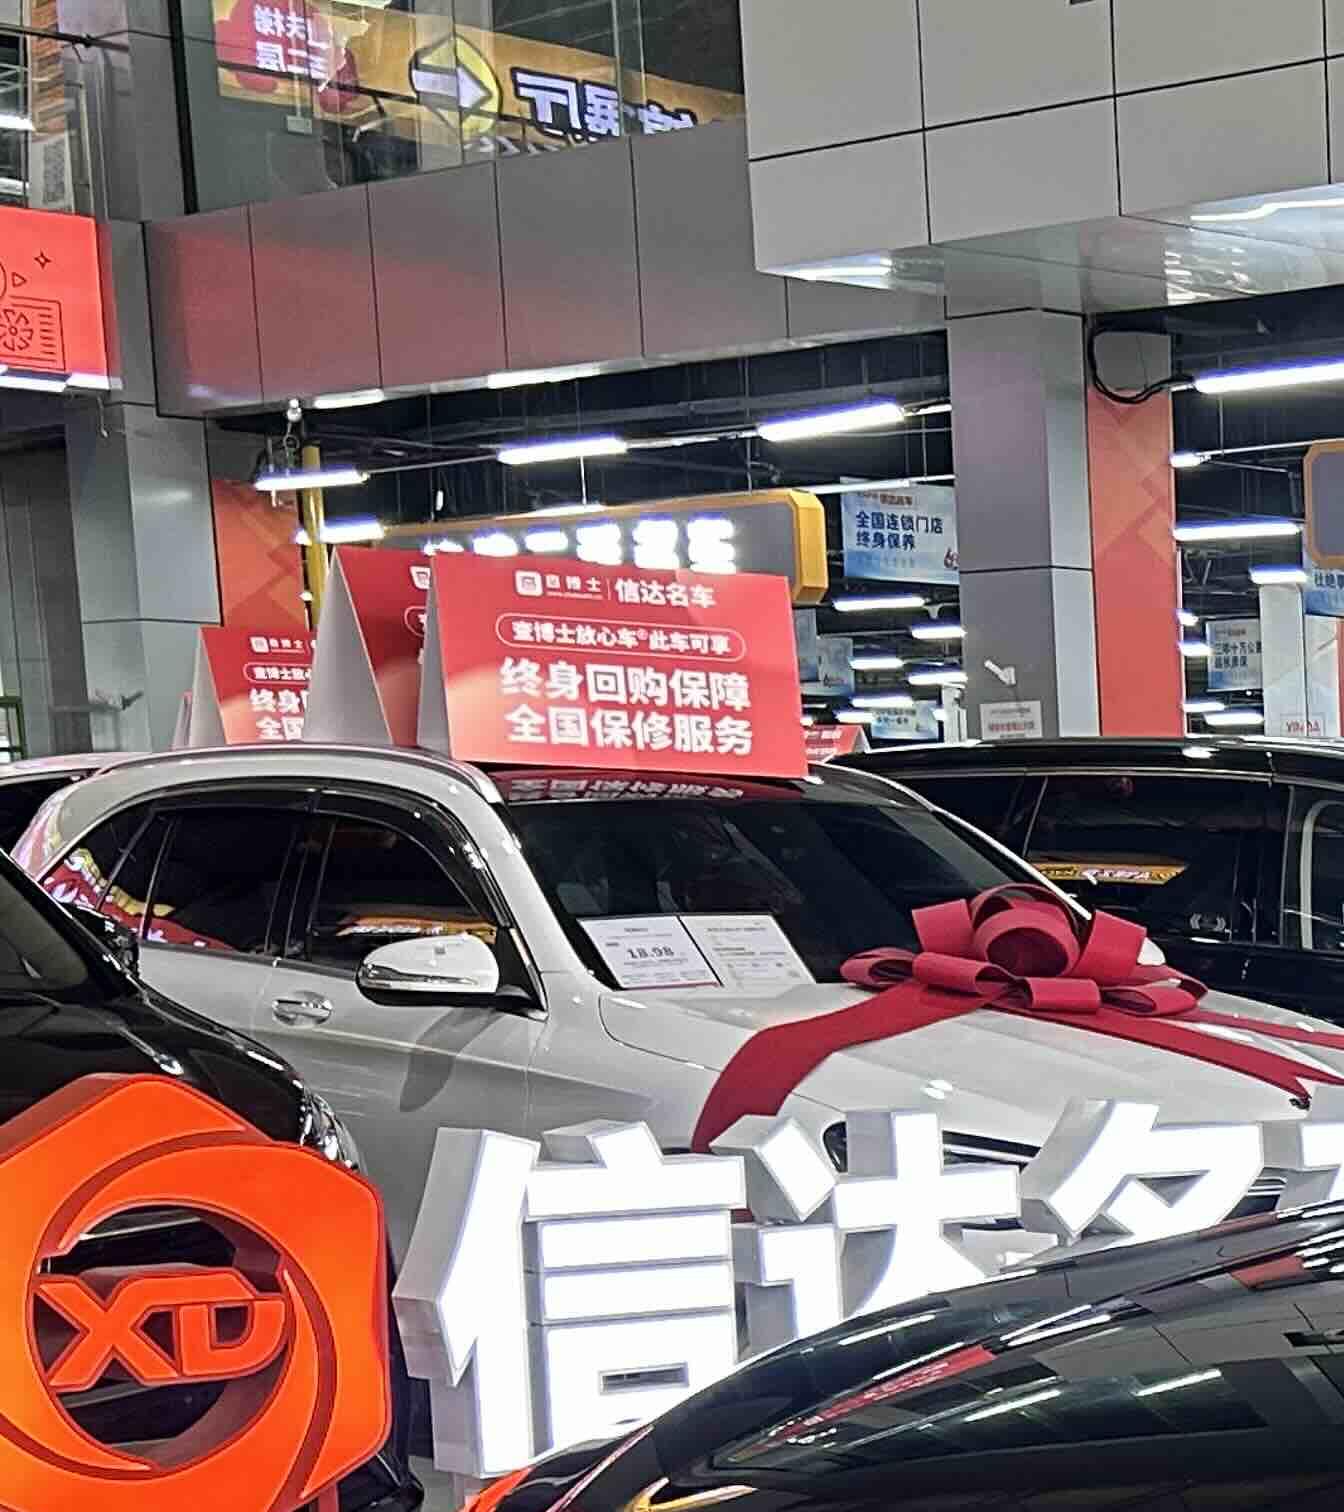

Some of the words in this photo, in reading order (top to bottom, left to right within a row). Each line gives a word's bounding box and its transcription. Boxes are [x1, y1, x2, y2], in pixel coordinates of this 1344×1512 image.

[615, 577, 717, 609] 信达名车
[250, 688, 309, 714] 终身
[499, 656, 753, 713] 终身回购保障
[504, 703, 753, 757] 全国保修服务
